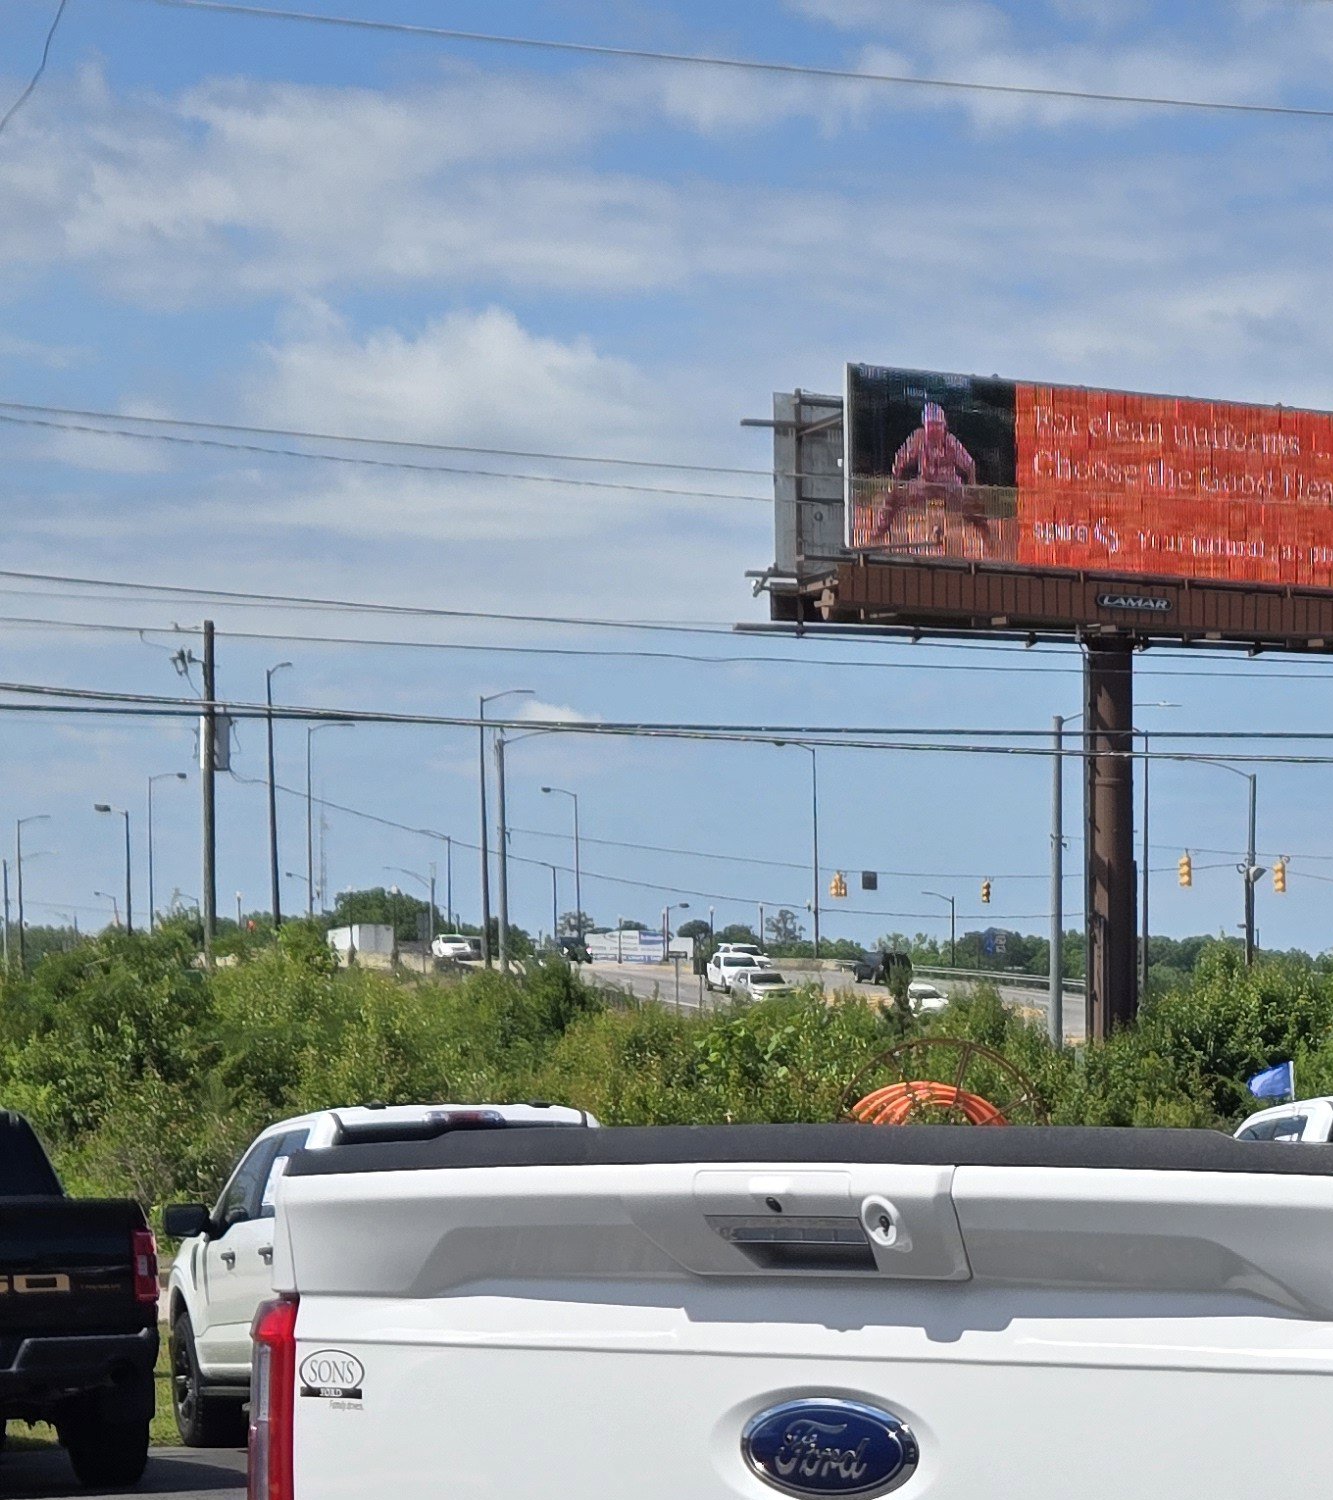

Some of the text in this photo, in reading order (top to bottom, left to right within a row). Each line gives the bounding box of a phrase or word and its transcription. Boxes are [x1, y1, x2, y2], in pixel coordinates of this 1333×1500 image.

[1089, 411, 1162, 444] clean
[1032, 449, 1138, 486] Choose
[1148, 458, 1192, 490] the
[1200, 464, 1274, 497] Good
[1103, 595, 1169, 609] LAMAR
[308, 1359, 355, 1385] SONS
[774, 1418, 871, 1480] Ford
